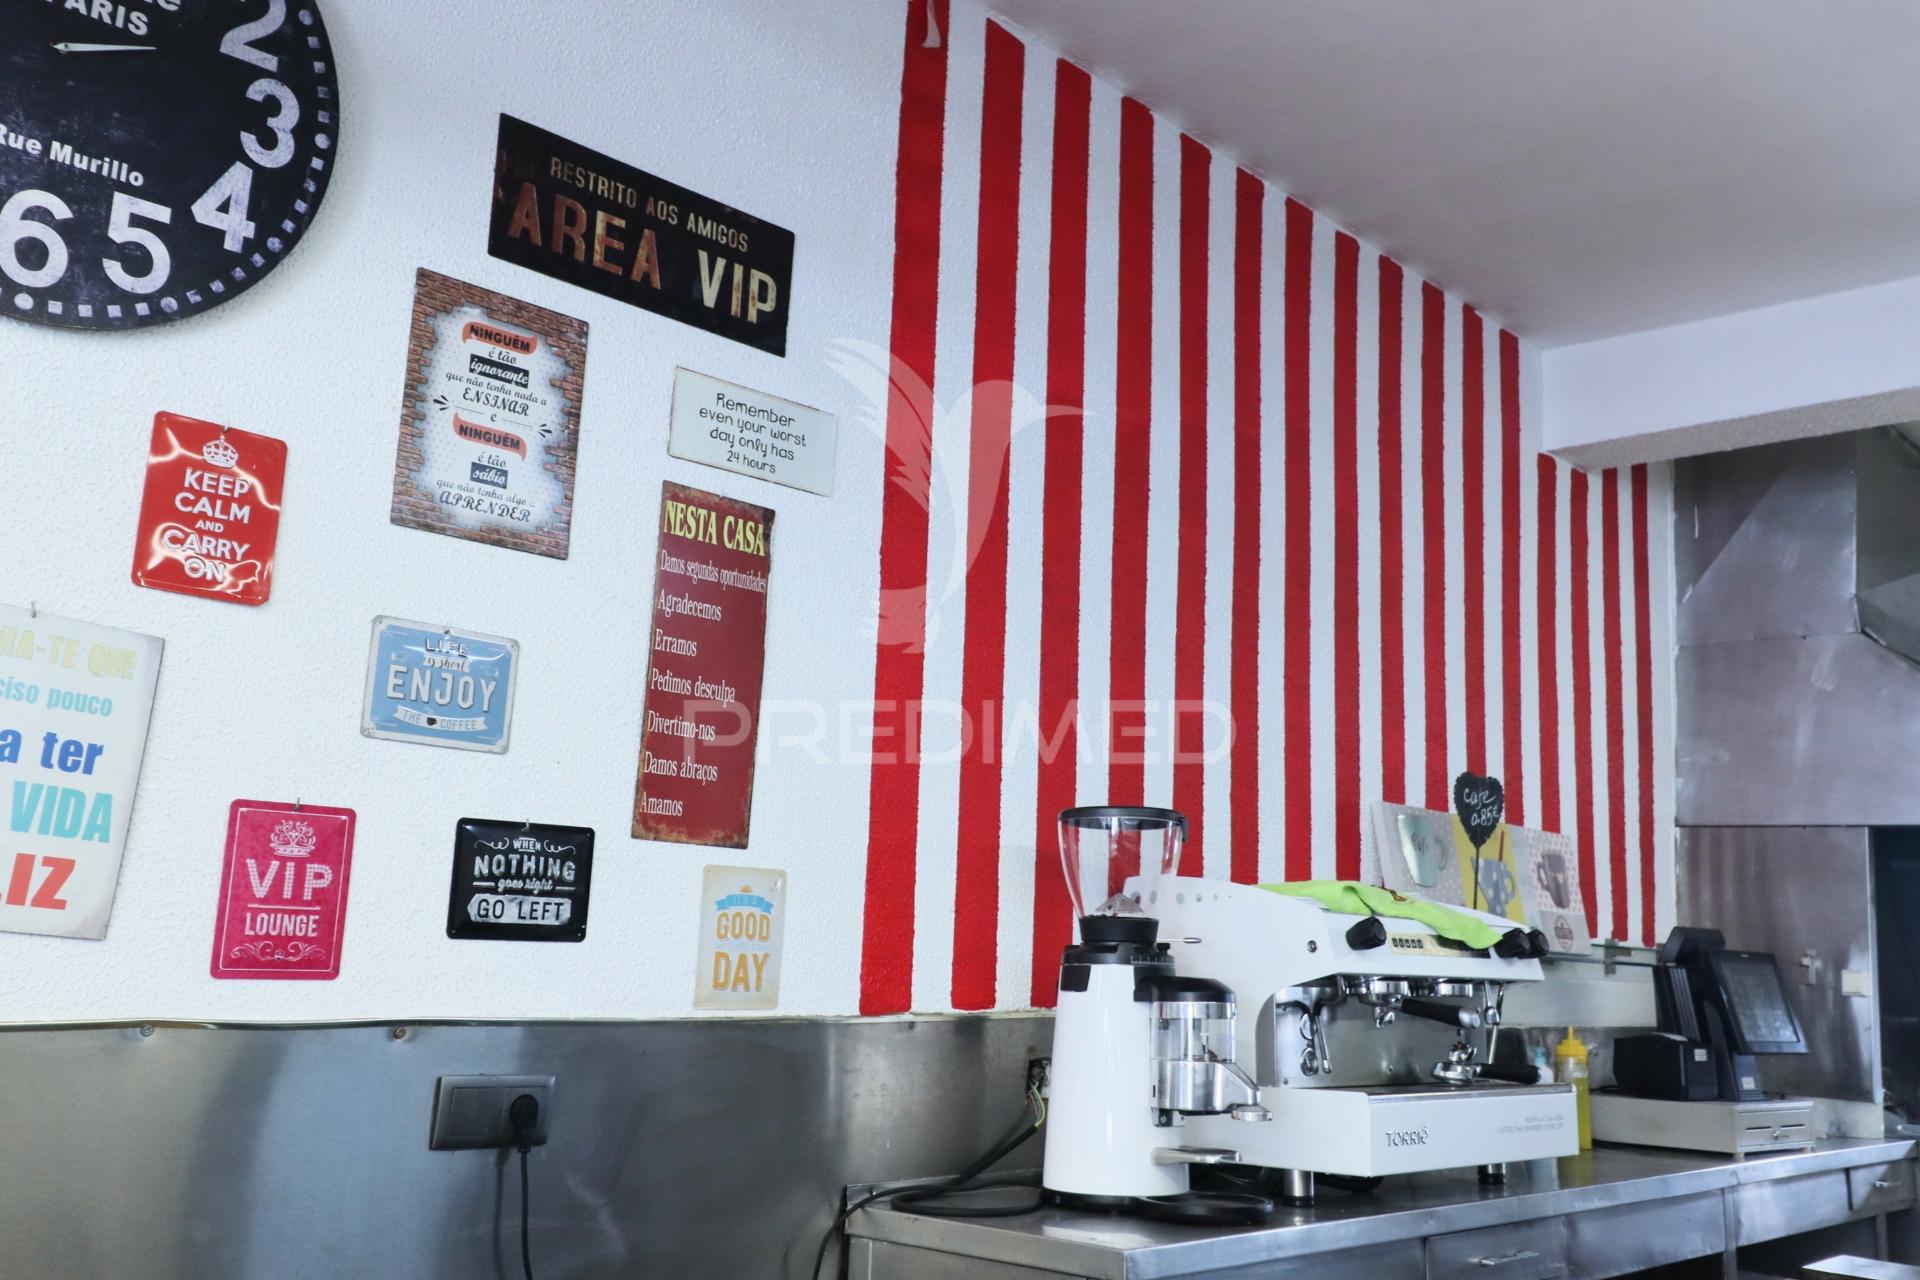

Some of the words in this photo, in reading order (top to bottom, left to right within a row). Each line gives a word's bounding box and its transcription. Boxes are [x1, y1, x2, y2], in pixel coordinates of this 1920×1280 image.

[46, 0, 149, 36] ARIS
[219, 0, 287, 73] 2
[240, 77, 300, 168] 3
[49, 140, 144, 187] Murillo
[190, 160, 256, 254] 4
[550, 156, 637, 209] RESTRITO
[645, 196, 678, 226] AOS
[686, 212, 749, 253] AMIGOS
[0, 189, 74, 288] 6
[101, 190, 172, 294] 5
[507, 182, 661, 290] AREA
[697, 248, 777, 325] VIP
[469, 325, 531, 353] NINGUÉM
[470, 358, 529, 386] ignorante
[497, 349, 517, 365] tão
[446, 371, 464, 383] que
[466, 376, 484, 388] não
[486, 381, 512, 397] tenha
[514, 389, 538, 404] nada
[462, 387, 529, 417] ENSINAR
[490, 413, 498, 422] e
[716, 392, 797, 428] Remember
[459, 420, 520, 451] NINGUÉM
[699, 407, 734, 426] even
[737, 419, 767, 434] your
[770, 430, 808, 447] worst
[709, 427, 736, 449] day
[738, 438, 768, 459] only
[771, 443, 795, 461] has
[471, 466, 507, 485] sábio
[487, 453, 507, 468] tão
[726, 450, 740, 464] 24
[742, 454, 776, 474] hours
[184, 468, 249, 498] KEEP
[175, 492, 250, 523] CALM
[439, 490, 532, 523] APRENDER
[195, 519, 224, 533] AND
[663, 499, 718, 545] NESTA
[723, 515, 766, 556] CASA
[161, 529, 250, 561] CARRY
[184, 556, 225, 582] ON
[660, 549, 686, 576] Damos
[686, 560, 720, 584] segundas
[720, 567, 767, 593] oportunidades
[658, 589, 722, 621] Agradecemos
[654, 628, 697, 657] Erramos
[87, 643, 137, 680] QUE
[46, 687, 113, 717] pouco
[387, 664, 496, 713] ENJOY
[650, 668, 692, 696] Pedimos
[694, 675, 736, 708] desculpa
[402, 710, 423, 724] THE
[440, 719, 477, 730] COFFEE
[647, 710, 716, 741] Divertimo-nos
[40, 731, 104, 775] ter
[644, 751, 678, 777] Damos
[680, 756, 718, 786] abraços
[10, 780, 113, 844] VIDA
[639, 791, 683, 816] Amamos
[513, 839, 541, 851] WHEN
[0, 852, 76, 911] IZ
[246, 858, 333, 901] VIP
[474, 854, 576, 883] NOTHING
[497, 878, 524, 893] goes
[524, 877, 553, 894] right
[244, 912, 320, 937] LOUNGE
[477, 898, 505, 919] GO
[518, 901, 564, 921] LEFT
[716, 911, 771, 942] GOOD
[712, 951, 769, 992] DAY
